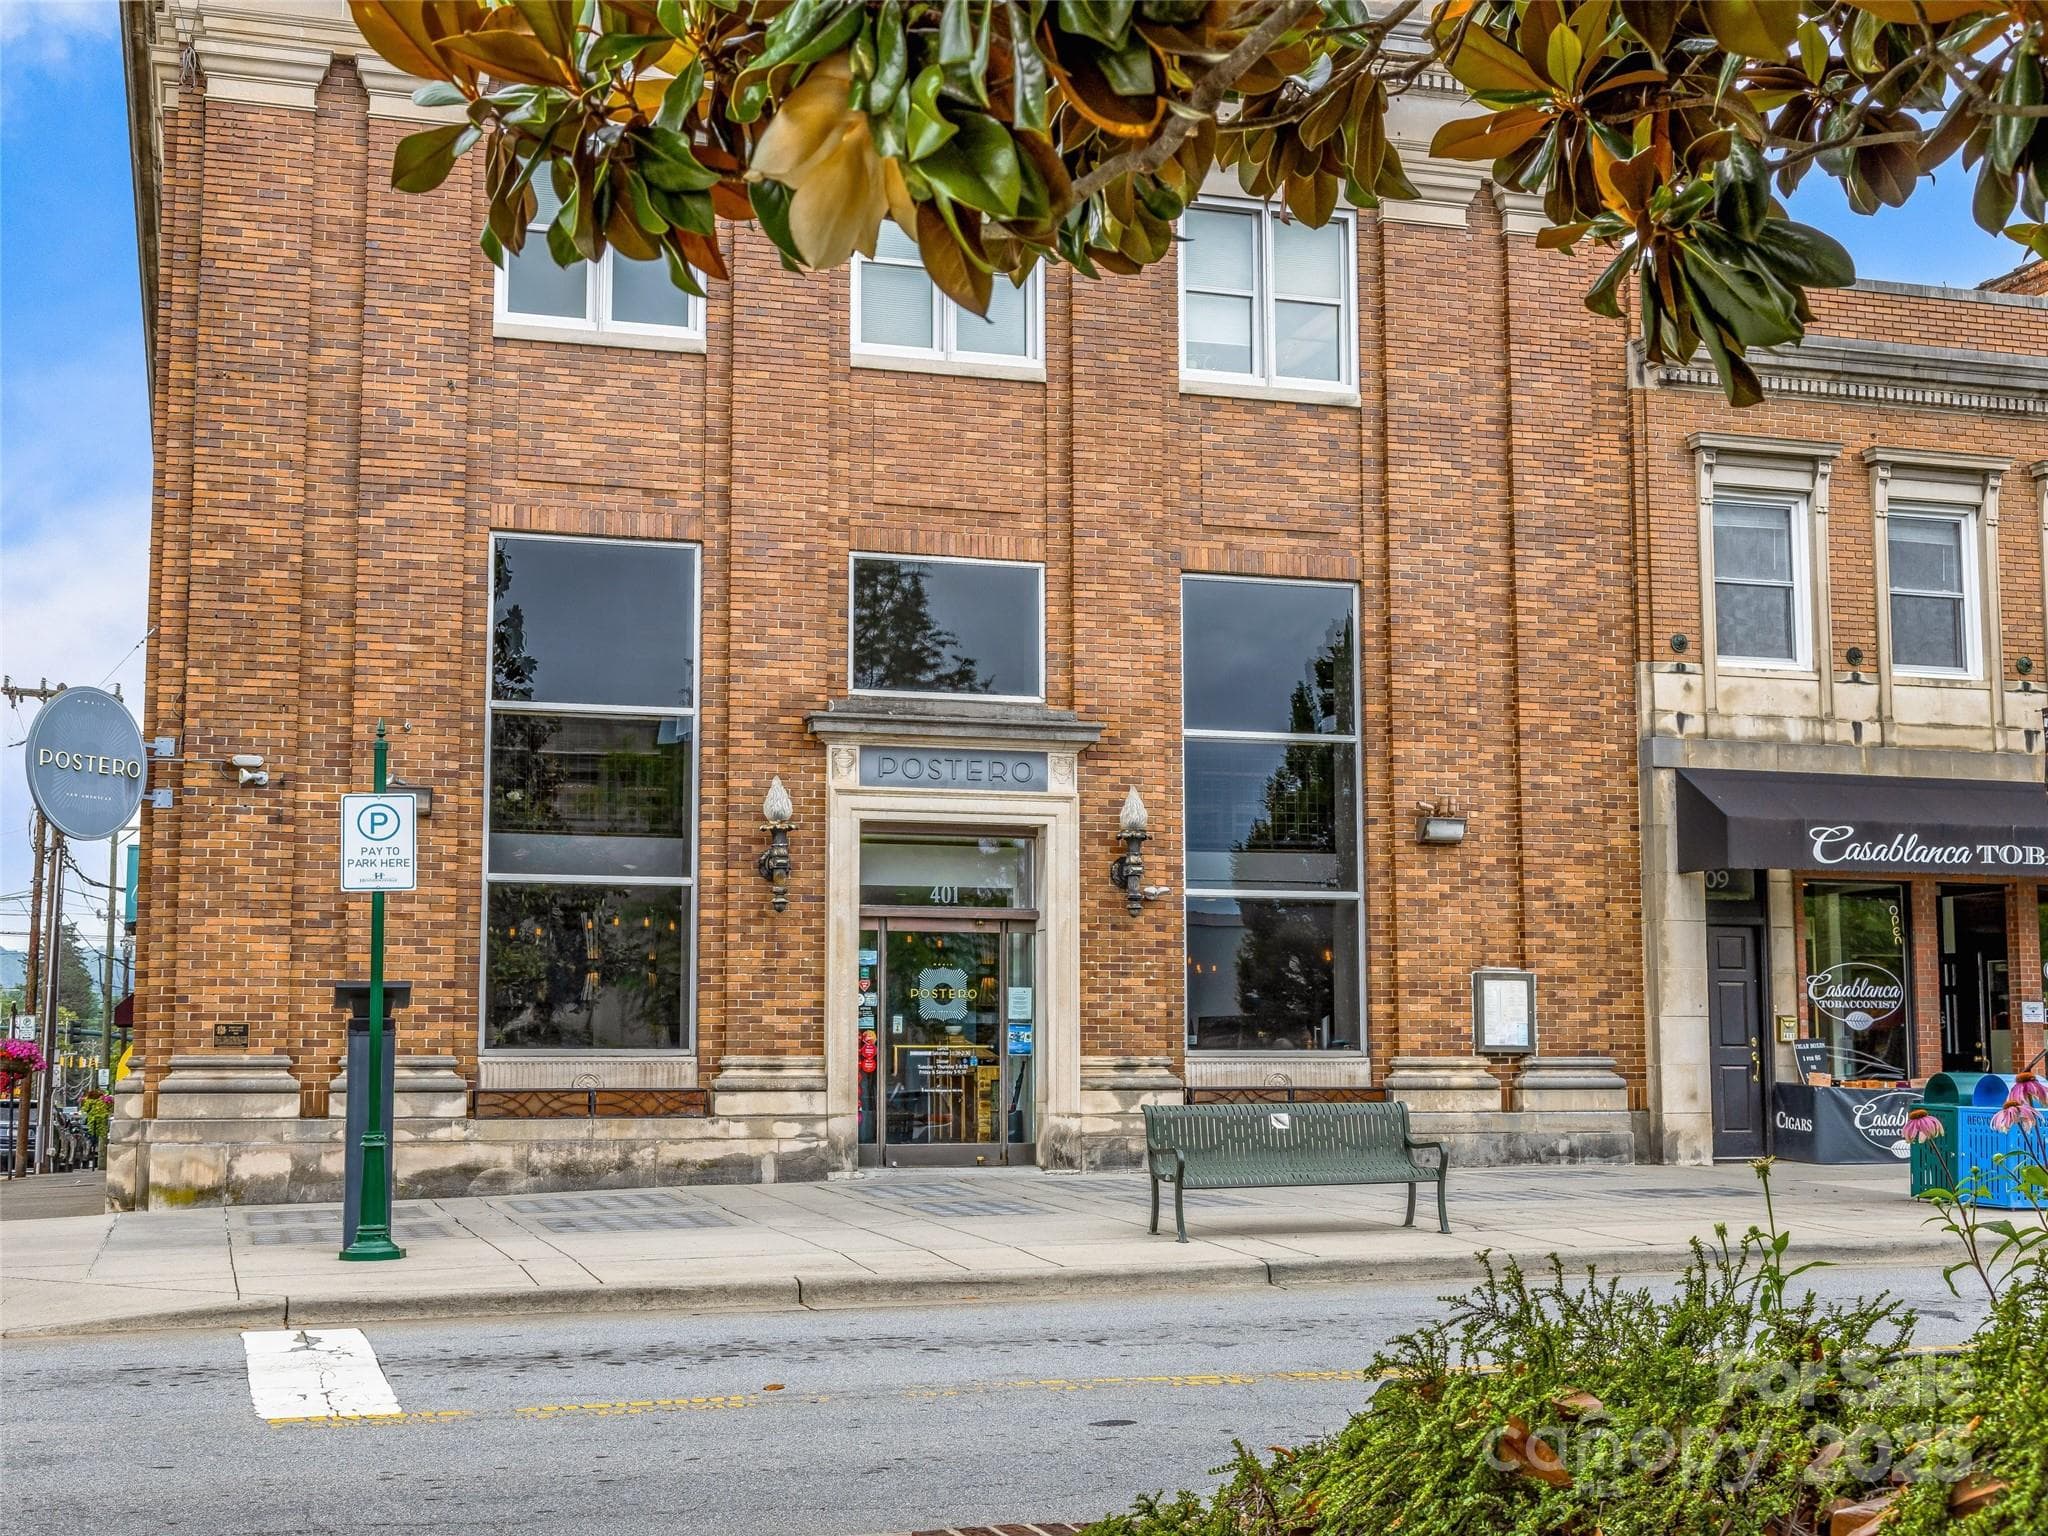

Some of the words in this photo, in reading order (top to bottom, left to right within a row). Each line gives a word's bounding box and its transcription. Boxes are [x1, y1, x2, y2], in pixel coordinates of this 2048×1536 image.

[39, 748, 141, 779] POSTERO
[878, 755, 1034, 783] POSTERO
[370, 812, 388, 834] P
[361, 846, 383, 856] PAY
[386, 846, 400, 856] TO
[1809, 825, 1973, 864] Casablanca
[1976, 844, 2048, 866] TOB
[347, 858, 378, 868] PARK
[380, 858, 411, 868] HERE
[929, 885, 959, 904] 401
[910, 988, 978, 999] POSTERO
[1806, 973, 1901, 1000] Casablanca
[1819, 1000, 1898, 1009] TOBACCONIST
